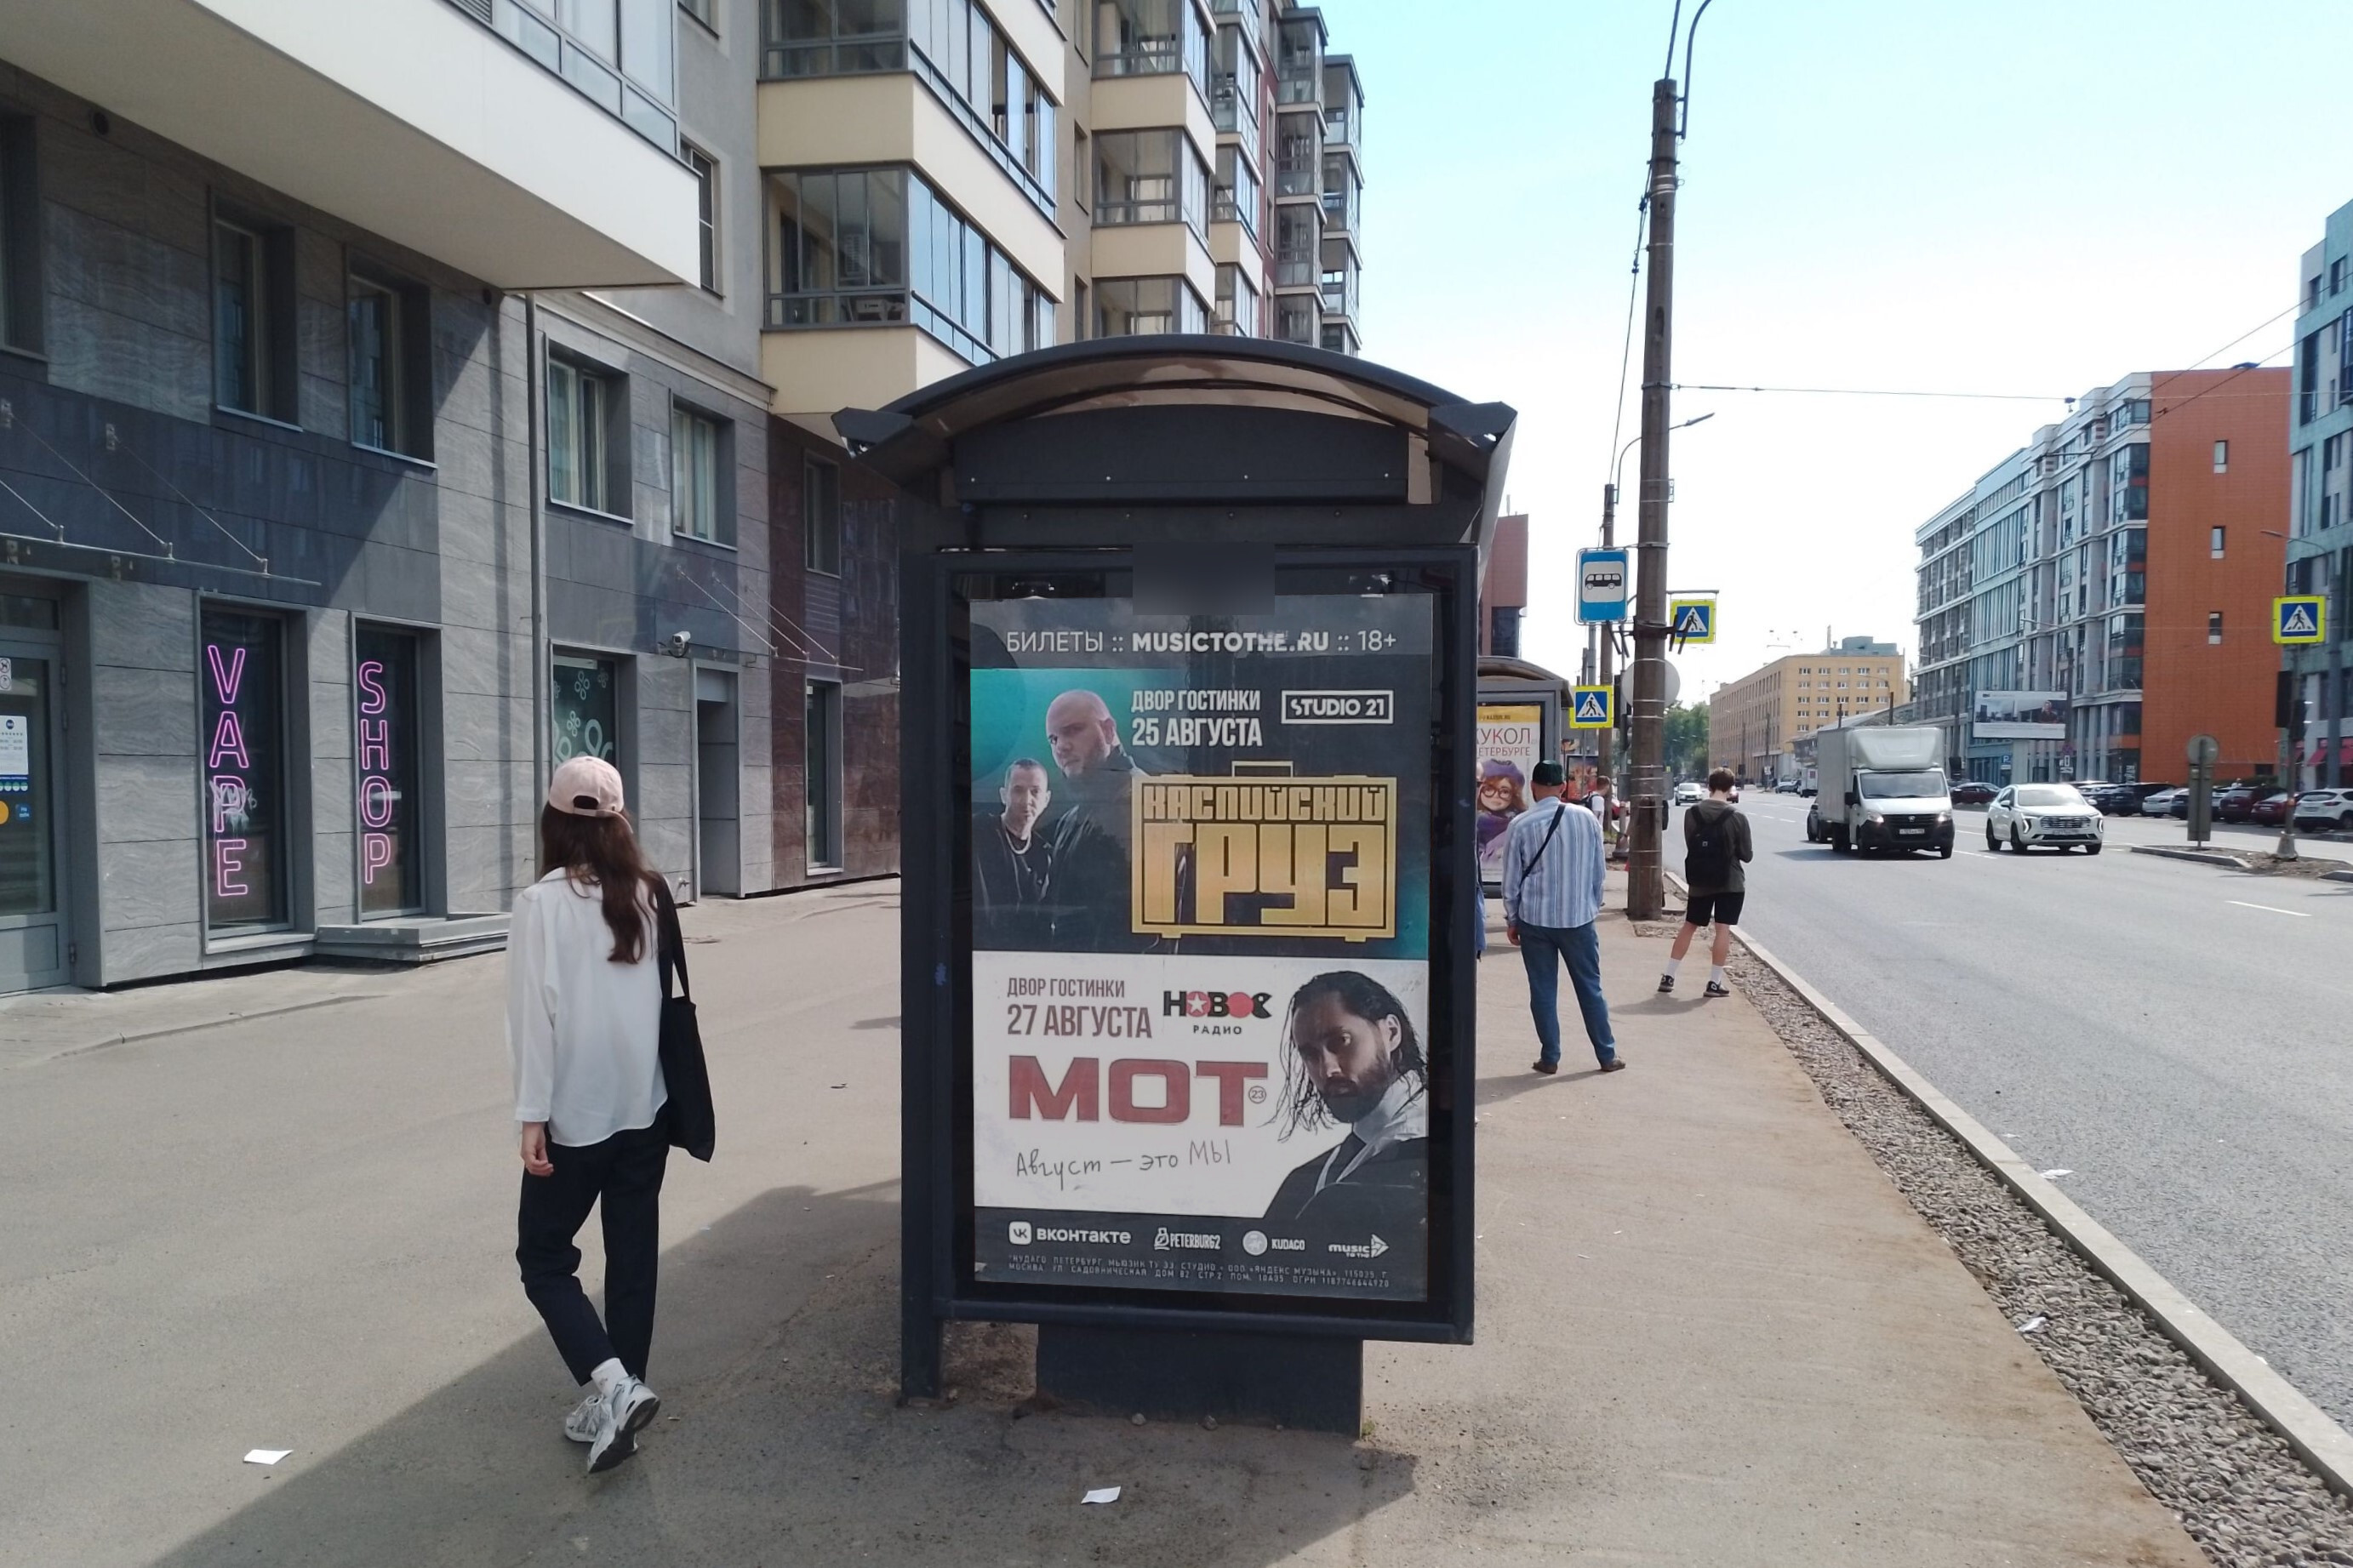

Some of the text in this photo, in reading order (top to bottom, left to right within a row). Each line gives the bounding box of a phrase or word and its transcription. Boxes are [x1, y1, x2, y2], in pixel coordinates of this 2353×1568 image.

[1006, 630, 1104, 653] БИЛЕТЫ
[1131, 630, 1330, 653] MUSICTOTHE.RU
[1356, 629, 1397, 652] 18+
[1130, 689, 1262, 713] ДВОР ГОСТИНКИ
[1289, 698, 1385, 717] STUDIO 21
[1131, 716, 1264, 747] 25 АВГУСТА
[1477, 747, 1531, 757] ЕТЕРБУРГЕ
[207, 644, 249, 898] VAPE
[358, 660, 393, 885] SHOP
[1143, 784, 1386, 822] КАСПИЙСКИЙ
[1142, 821, 1386, 927] ГРУЗ
[1006, 977, 1126, 1000] ДВОР ГОСТИНКИ
[1006, 1003, 1153, 1040] 27 АВГУСТА
[1192, 1024, 1243, 1035] РАДИО
[1008, 1054, 1270, 1128] МОТ
[1016, 1148, 1101, 1192] Август
[1139, 1154, 1179, 1172] это
[1188, 1138, 1231, 1166] МЫ
[1271, 1237, 1306, 1251] KUDAGO
[1053, 1256, 1103, 1267] ПЕТЕРБУРГ
[1180, 1262, 1217, 1272] СТУДИО
[1292, 1274, 1316, 1285] ОГРН
